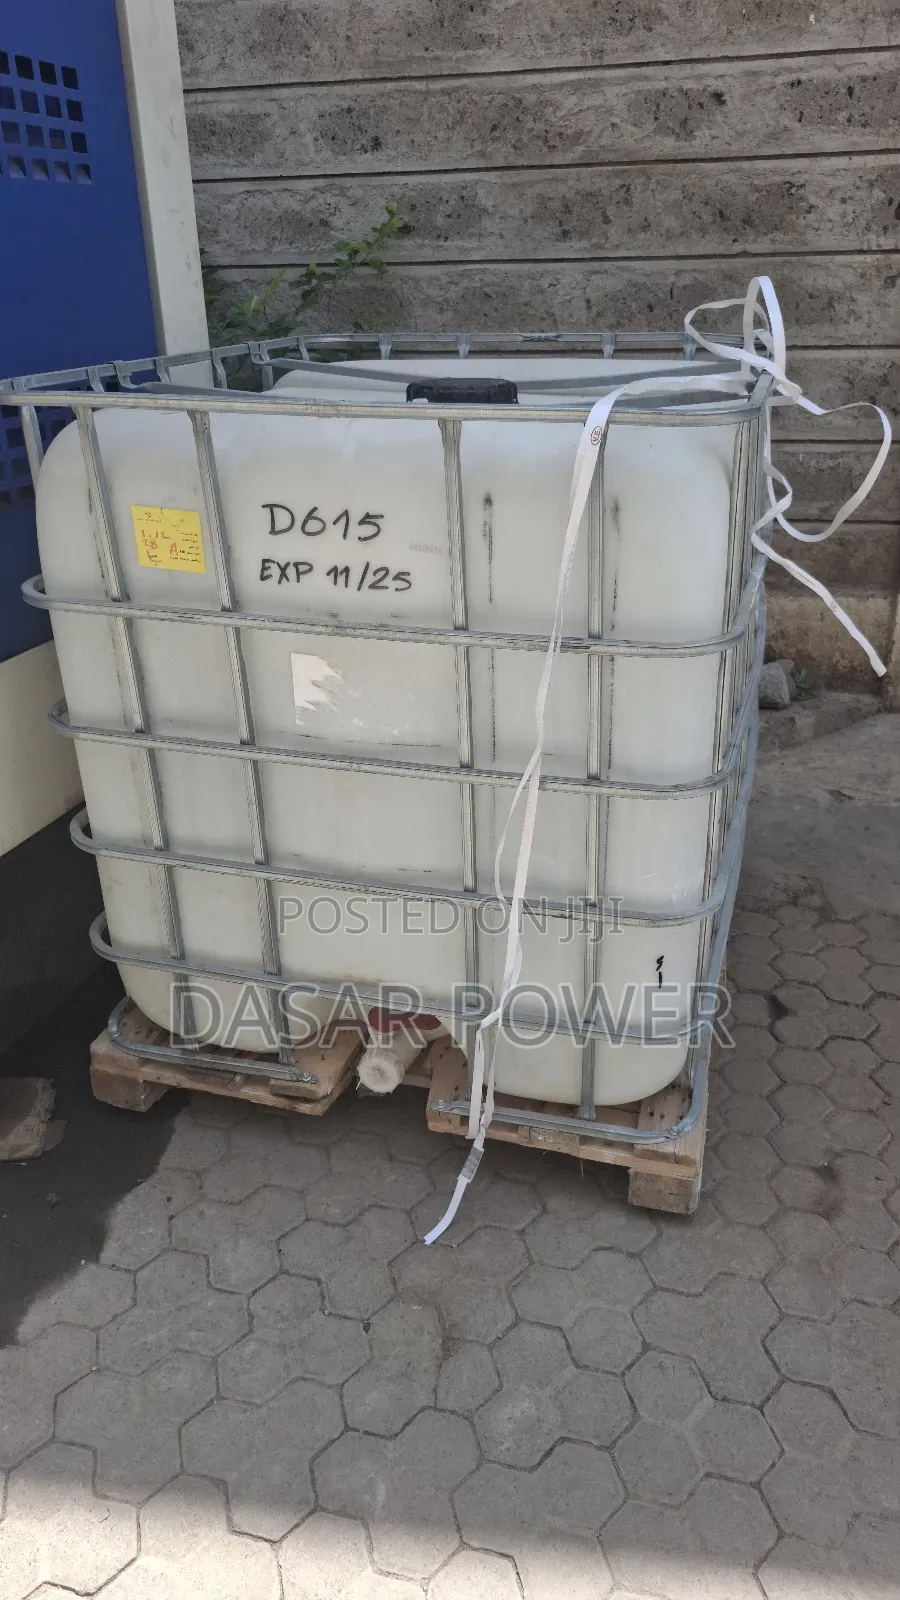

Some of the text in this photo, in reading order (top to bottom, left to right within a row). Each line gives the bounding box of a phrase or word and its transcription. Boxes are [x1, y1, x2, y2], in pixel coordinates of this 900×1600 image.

[261, 503, 385, 542] D615
[259, 558, 412, 592] EXP 11/25
